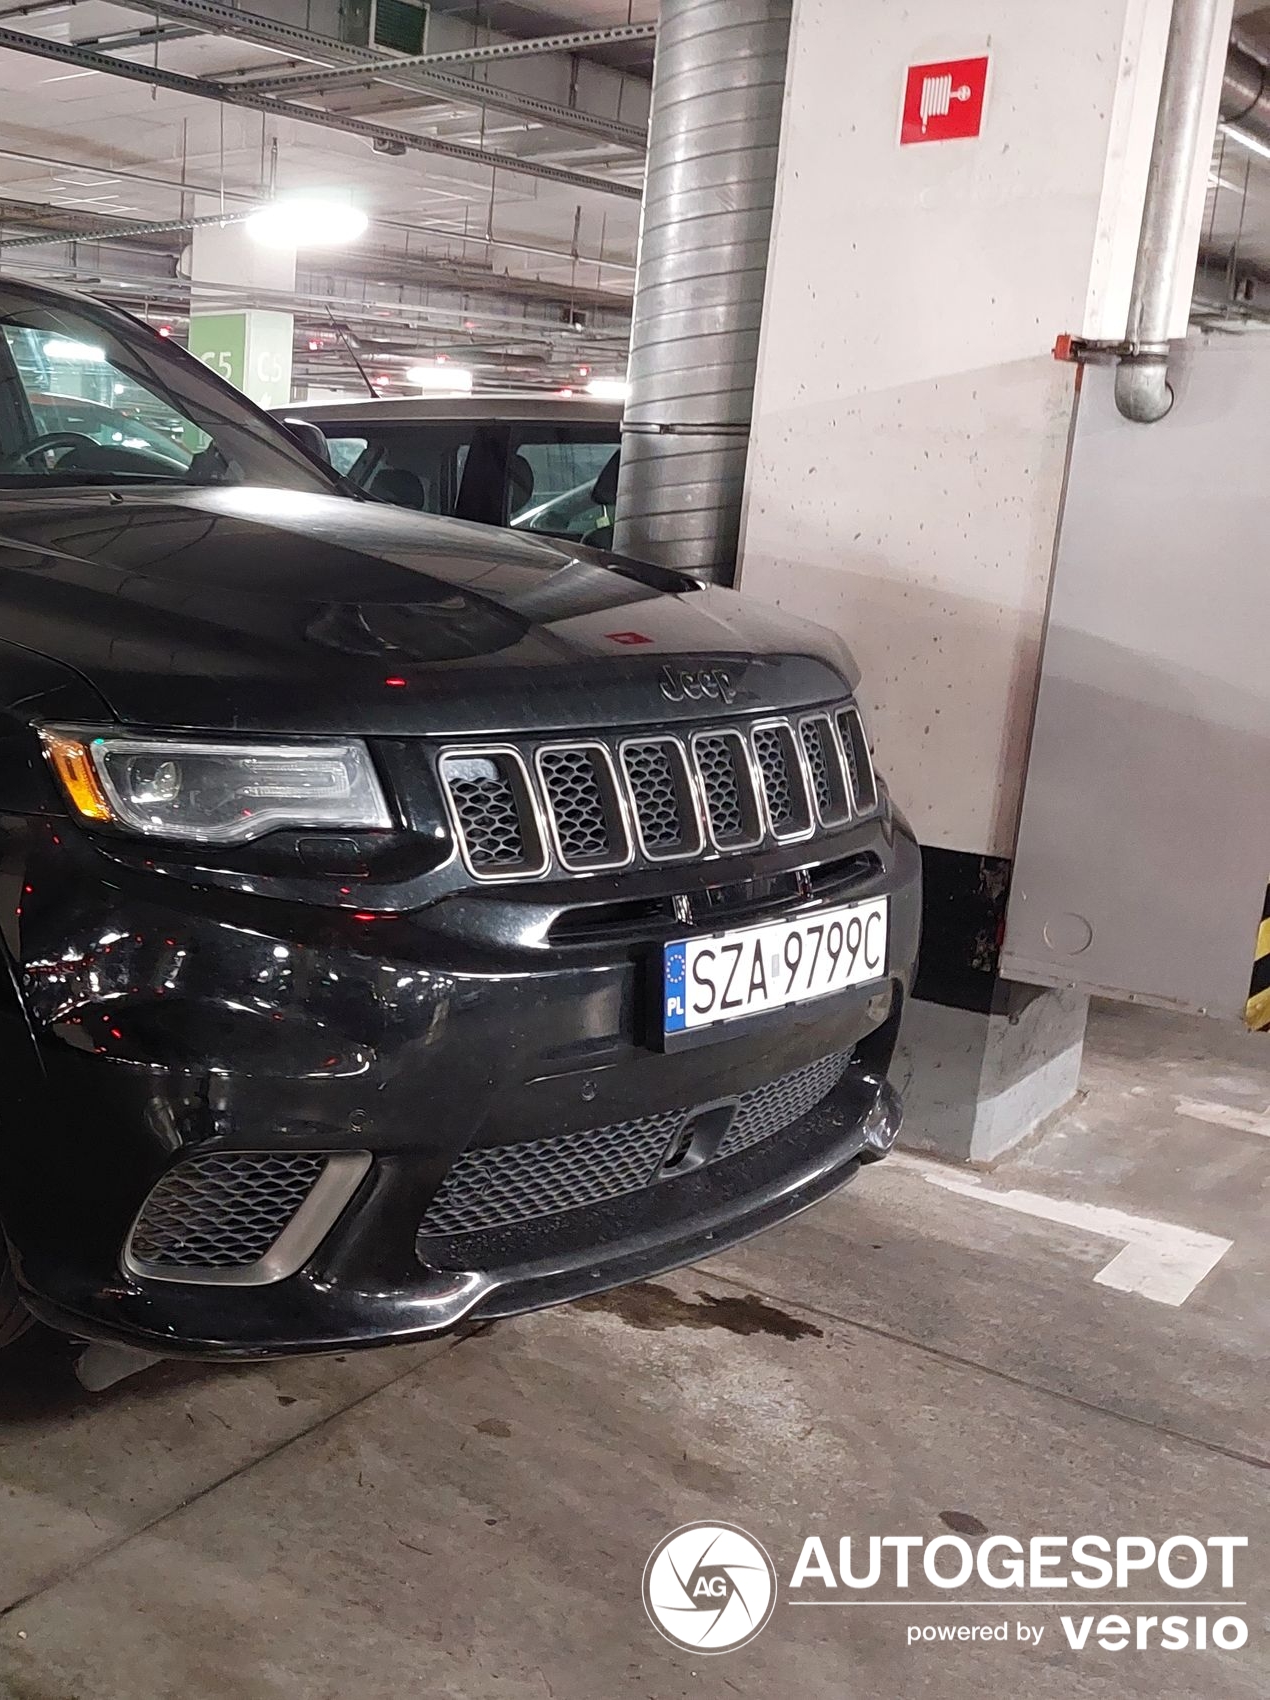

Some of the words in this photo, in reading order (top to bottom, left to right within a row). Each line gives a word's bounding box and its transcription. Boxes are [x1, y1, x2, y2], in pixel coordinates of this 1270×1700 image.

[257, 351, 283, 382] C5
[660, 664, 736, 704] Jeep
[692, 938, 768, 1014] SZA
[784, 911, 881, 995] 9799C
[667, 996, 684, 1017] PL
